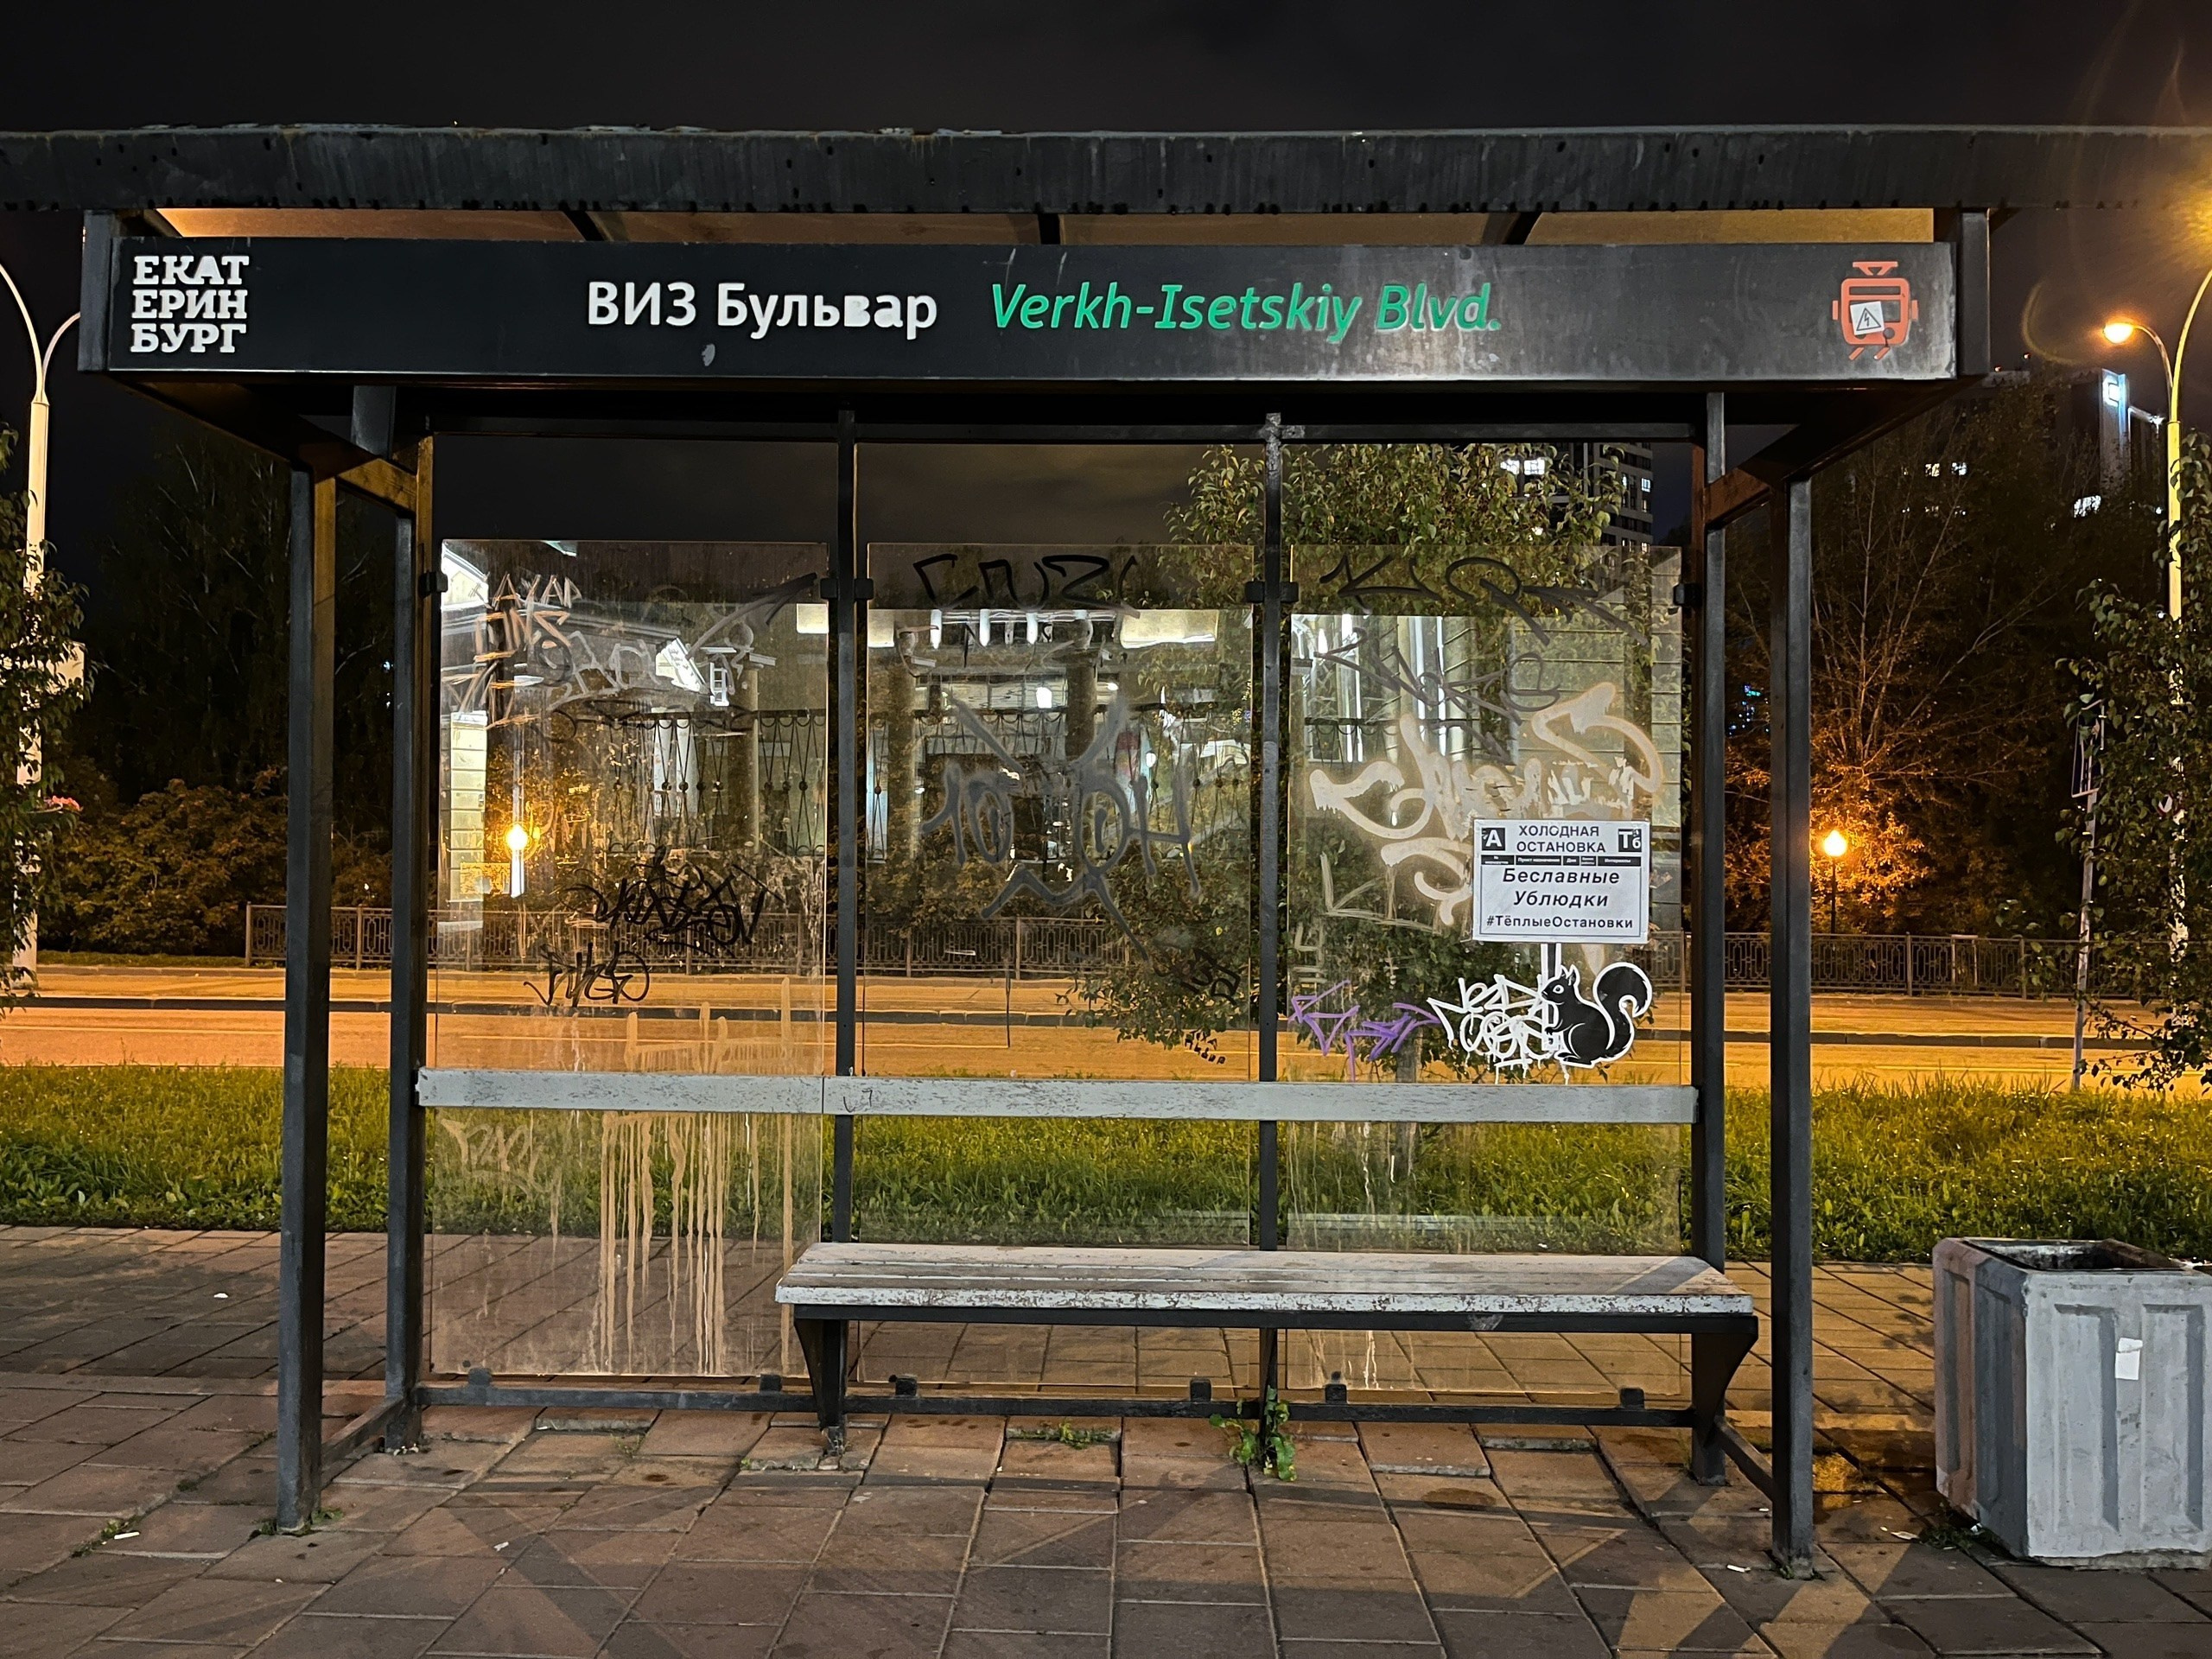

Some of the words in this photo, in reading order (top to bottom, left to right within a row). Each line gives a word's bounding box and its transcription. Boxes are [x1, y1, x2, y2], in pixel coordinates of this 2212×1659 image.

[132, 255, 250, 285] ЕКАТ
[131, 289, 248, 319] ЕРИН
[588, 282, 696, 326] ВИЗ
[717, 283, 938, 340] Бульвар
[992, 283, 1363, 343] Verkh-Isetskiy
[1376, 283, 1501, 331] Blvd.
[130, 322, 247, 353] БУРГ
[1518, 825, 1599, 838] ХОЛОДНАЯ
[1516, 842, 1606, 853] ОСТАНОВКА
[1503, 868, 1620, 884] Беславные
[1513, 891, 1609, 908] Ублюдки
[1486, 915, 1633, 929] #ТёплыеОстановки
